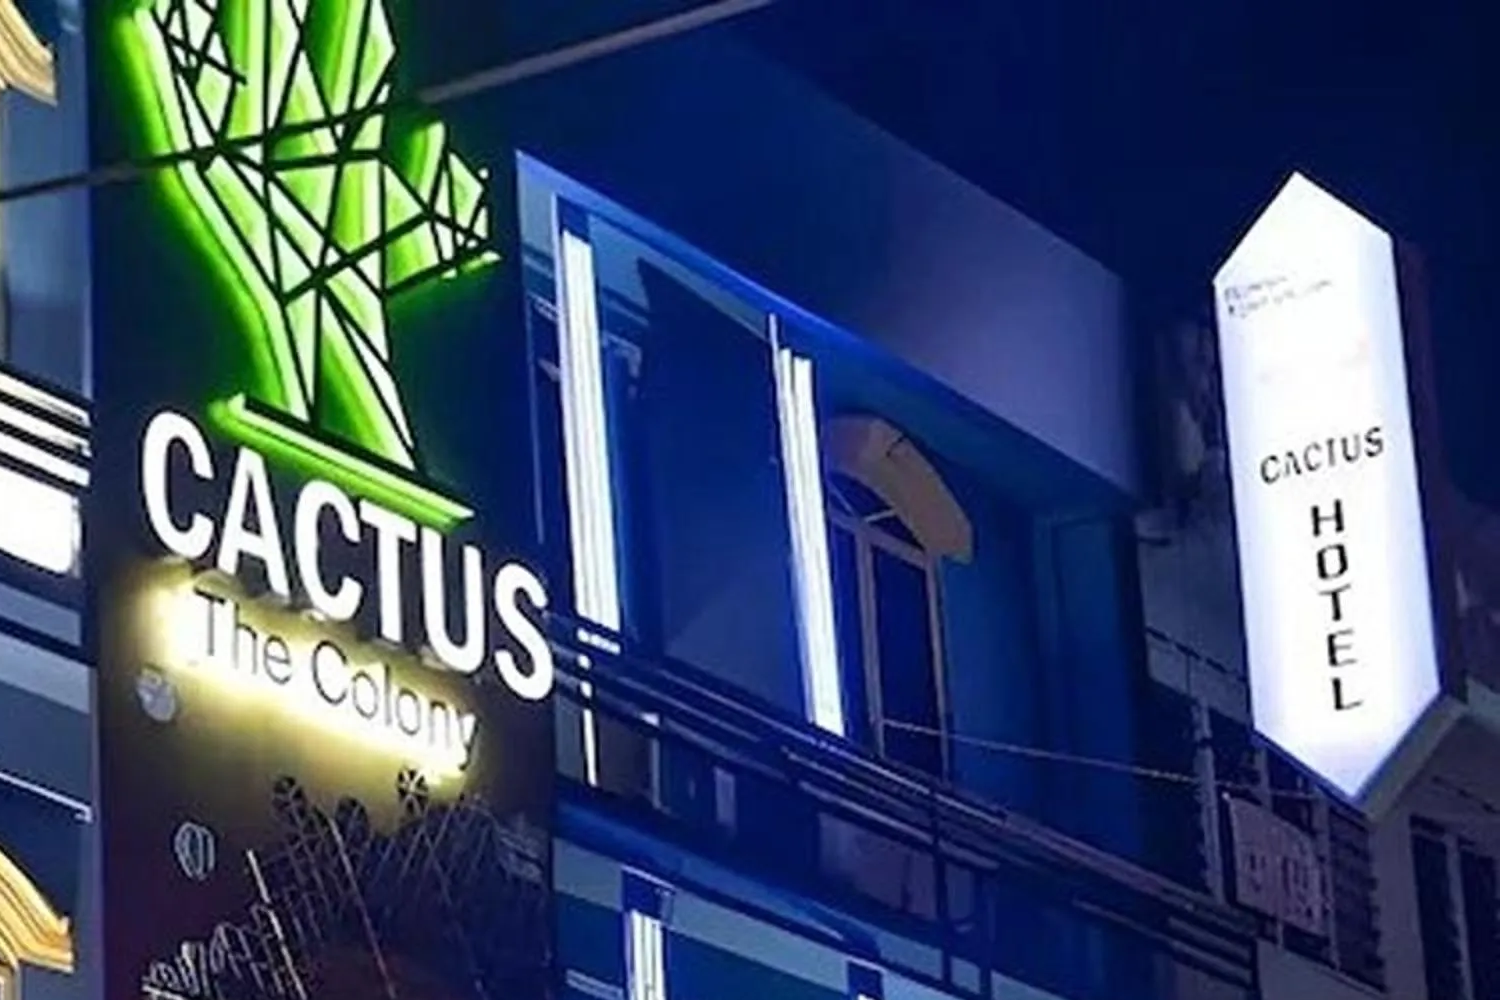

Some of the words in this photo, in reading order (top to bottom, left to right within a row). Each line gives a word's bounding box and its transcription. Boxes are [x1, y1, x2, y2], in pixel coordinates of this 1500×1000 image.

[1260, 427, 1384, 484] CACTUS
[142, 411, 554, 700] CACTUS
[1311, 498, 1363, 711] HOTEL
[194, 590, 292, 685] The
[312, 640, 479, 771] Colony
